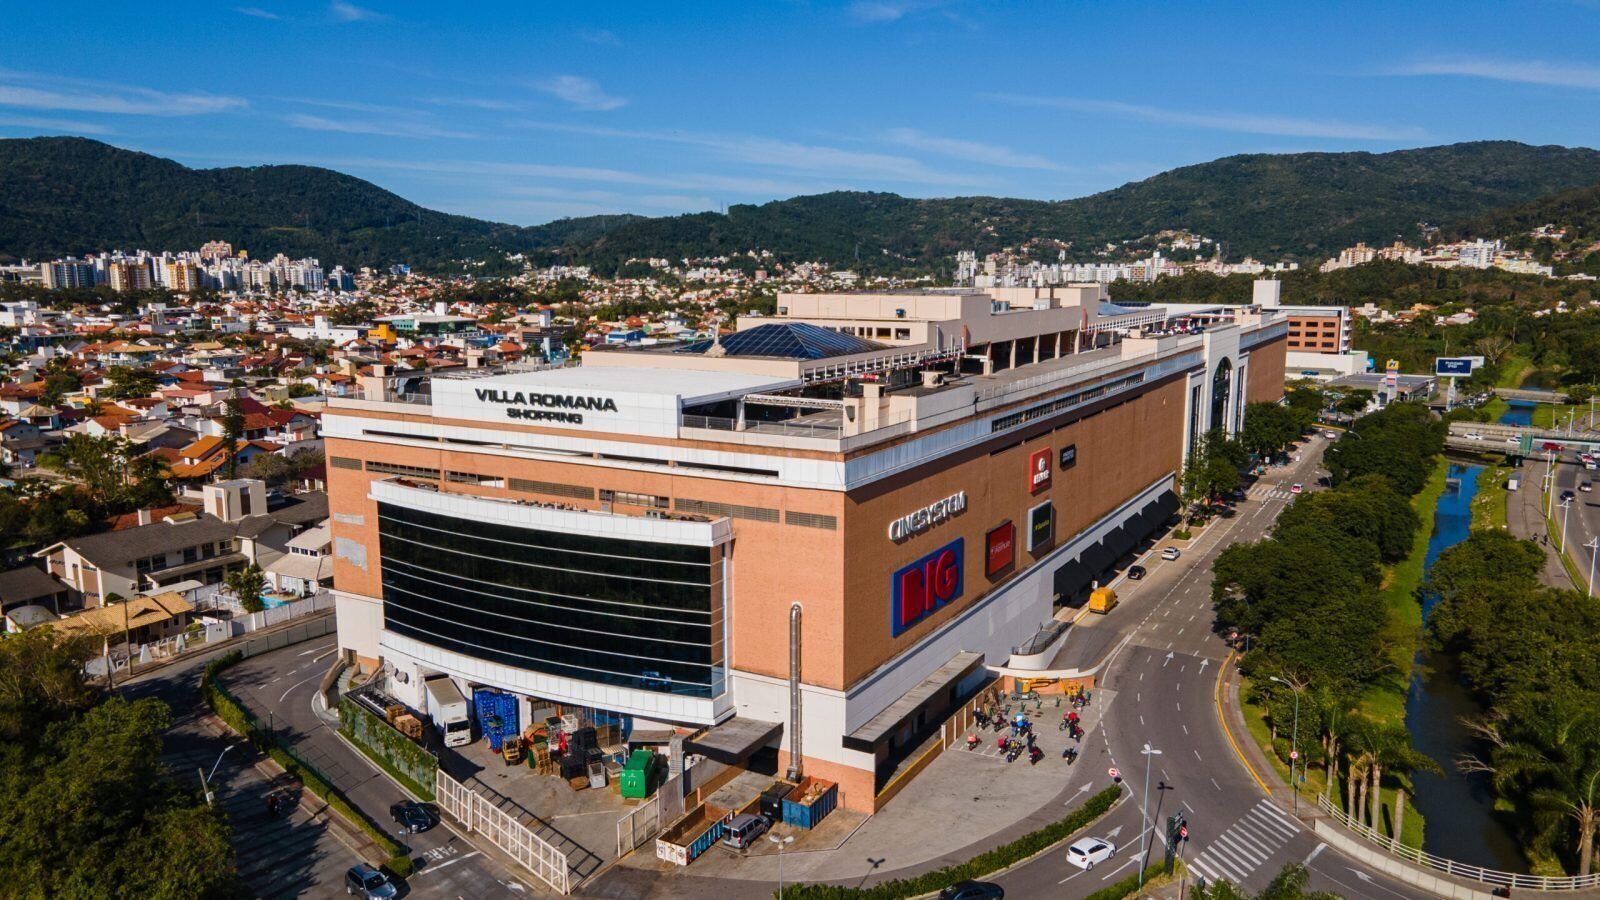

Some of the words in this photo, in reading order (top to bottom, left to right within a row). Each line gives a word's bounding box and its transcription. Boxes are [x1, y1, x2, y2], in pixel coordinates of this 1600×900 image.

[475, 388, 527, 405] VILLA
[529, 392, 618, 412] ROMANA
[507, 408, 583, 424] SHOPPING
[888, 490, 966, 542] CINESYSTEM
